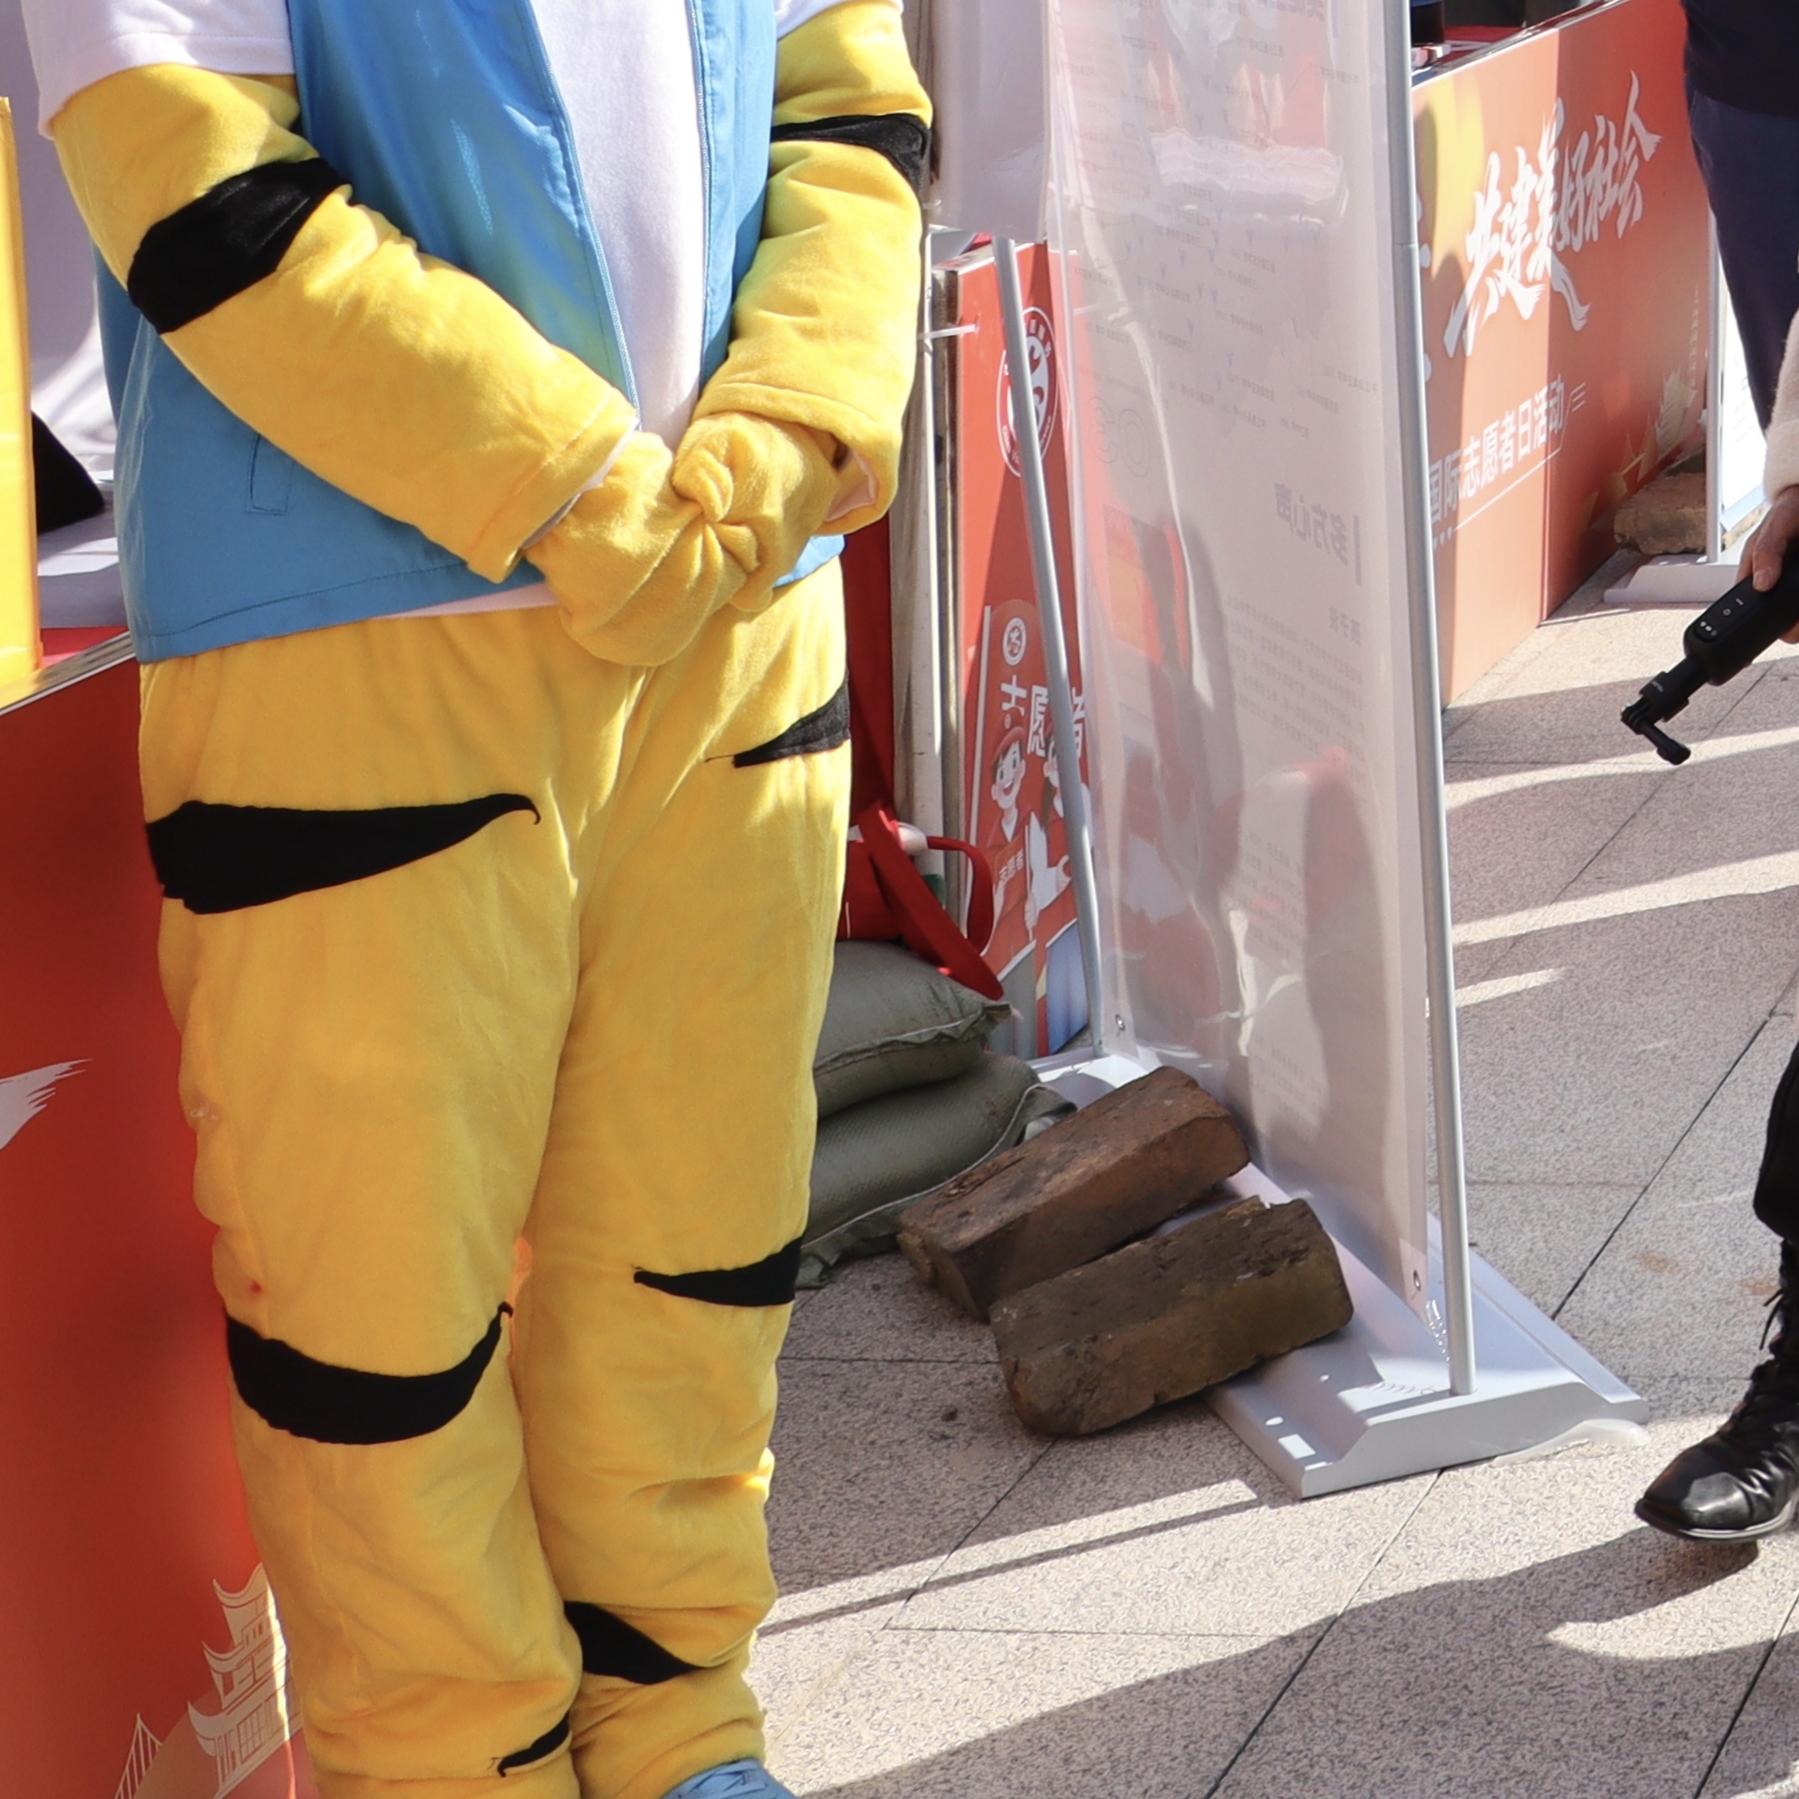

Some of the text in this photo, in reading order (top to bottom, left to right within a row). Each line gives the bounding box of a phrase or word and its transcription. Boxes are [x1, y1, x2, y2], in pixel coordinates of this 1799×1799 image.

[1443, 69, 1663, 358] 共建美好社会
